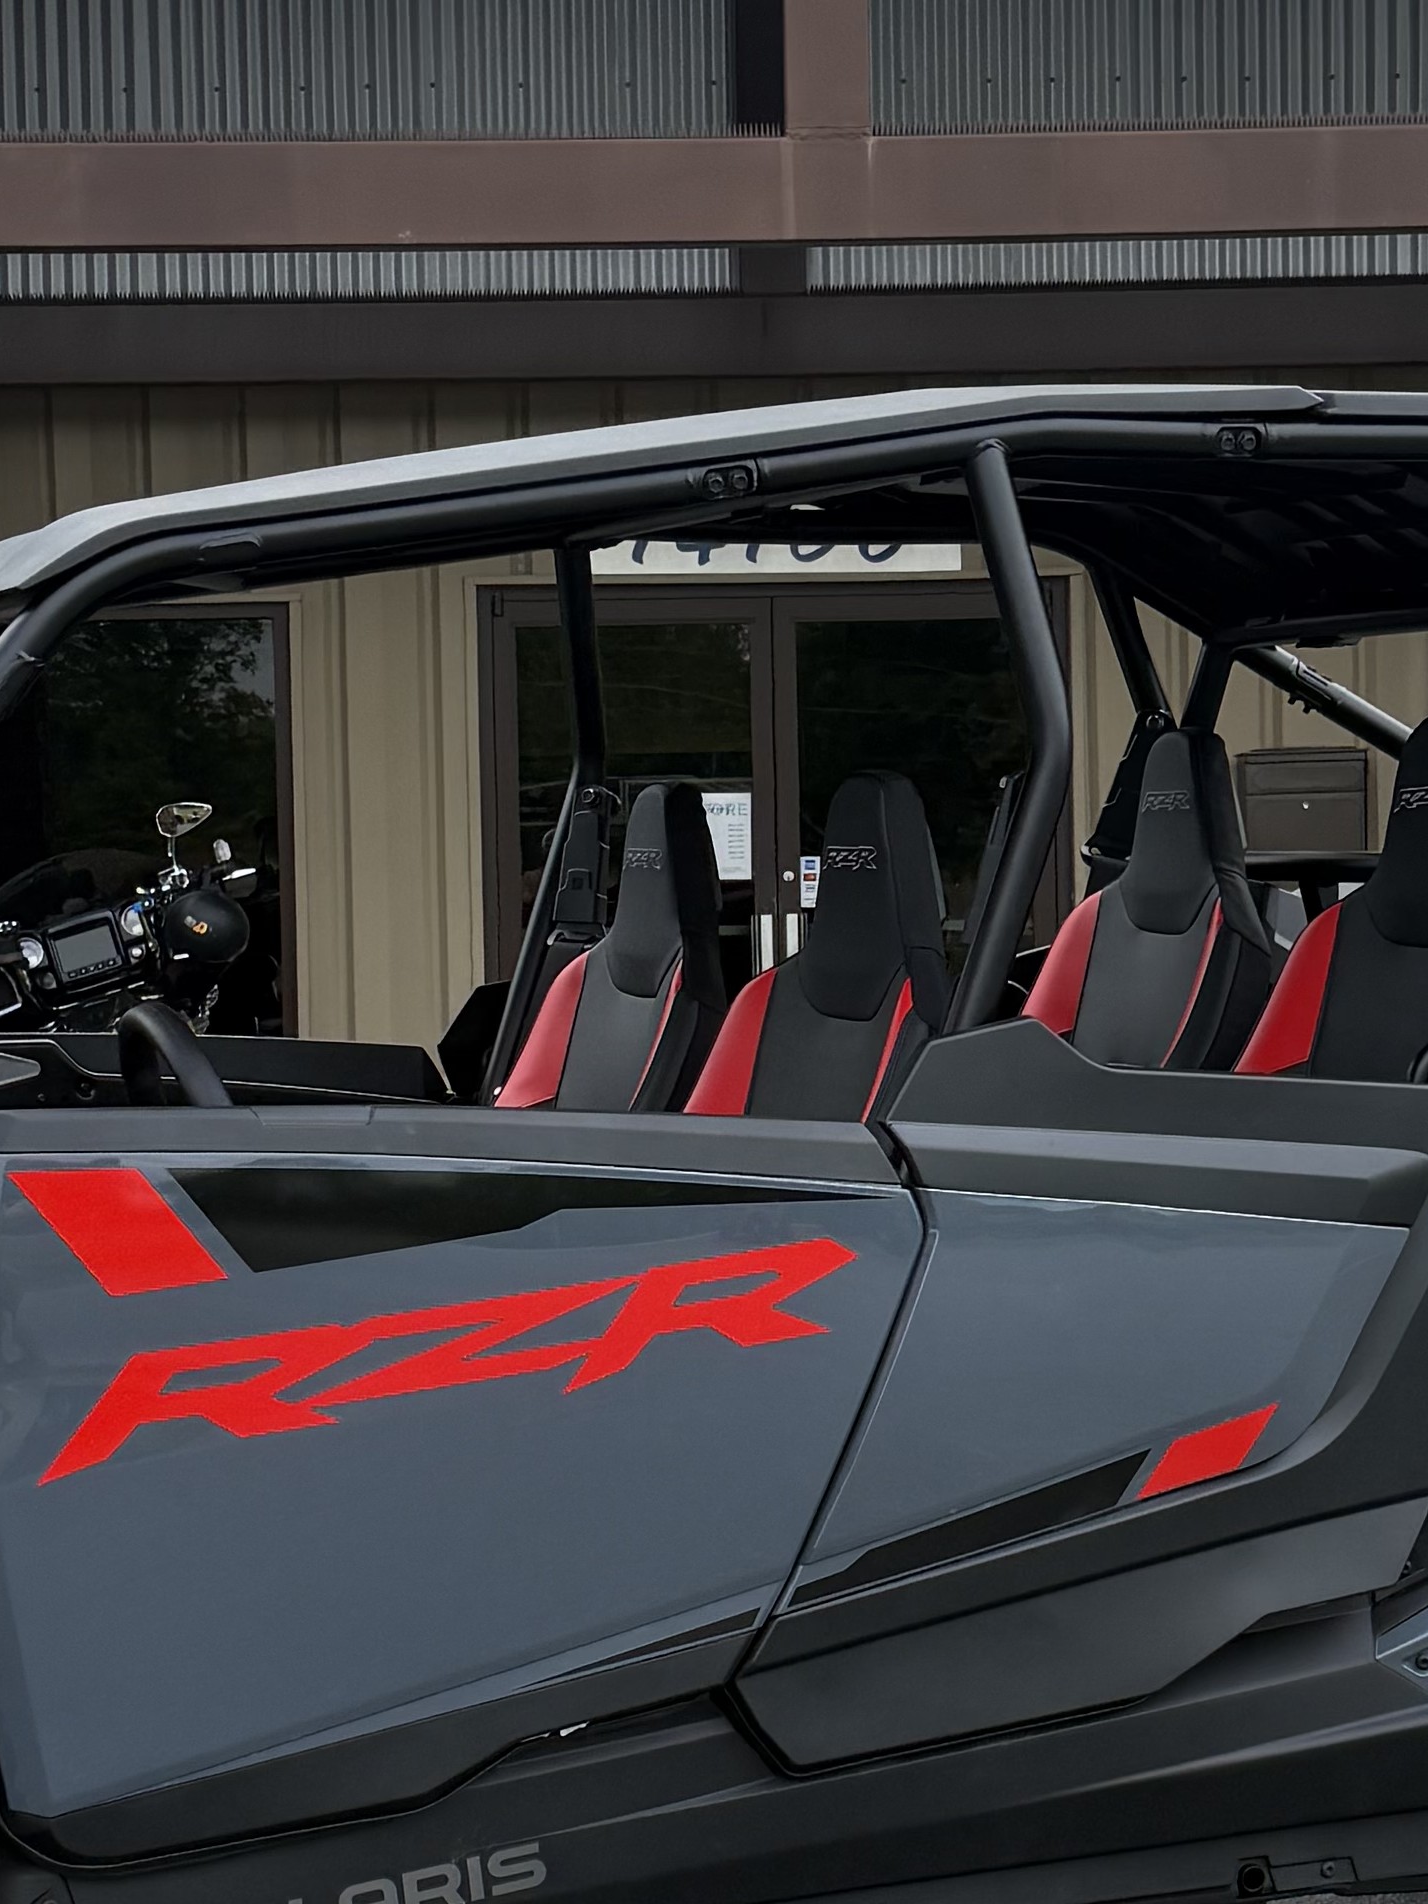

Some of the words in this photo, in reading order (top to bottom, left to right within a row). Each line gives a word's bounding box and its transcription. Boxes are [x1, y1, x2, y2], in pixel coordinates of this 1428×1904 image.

[1140, 789, 1191, 813] RZR
[822, 845, 878, 871] RZR
[36, 1236, 859, 1488] RZR
